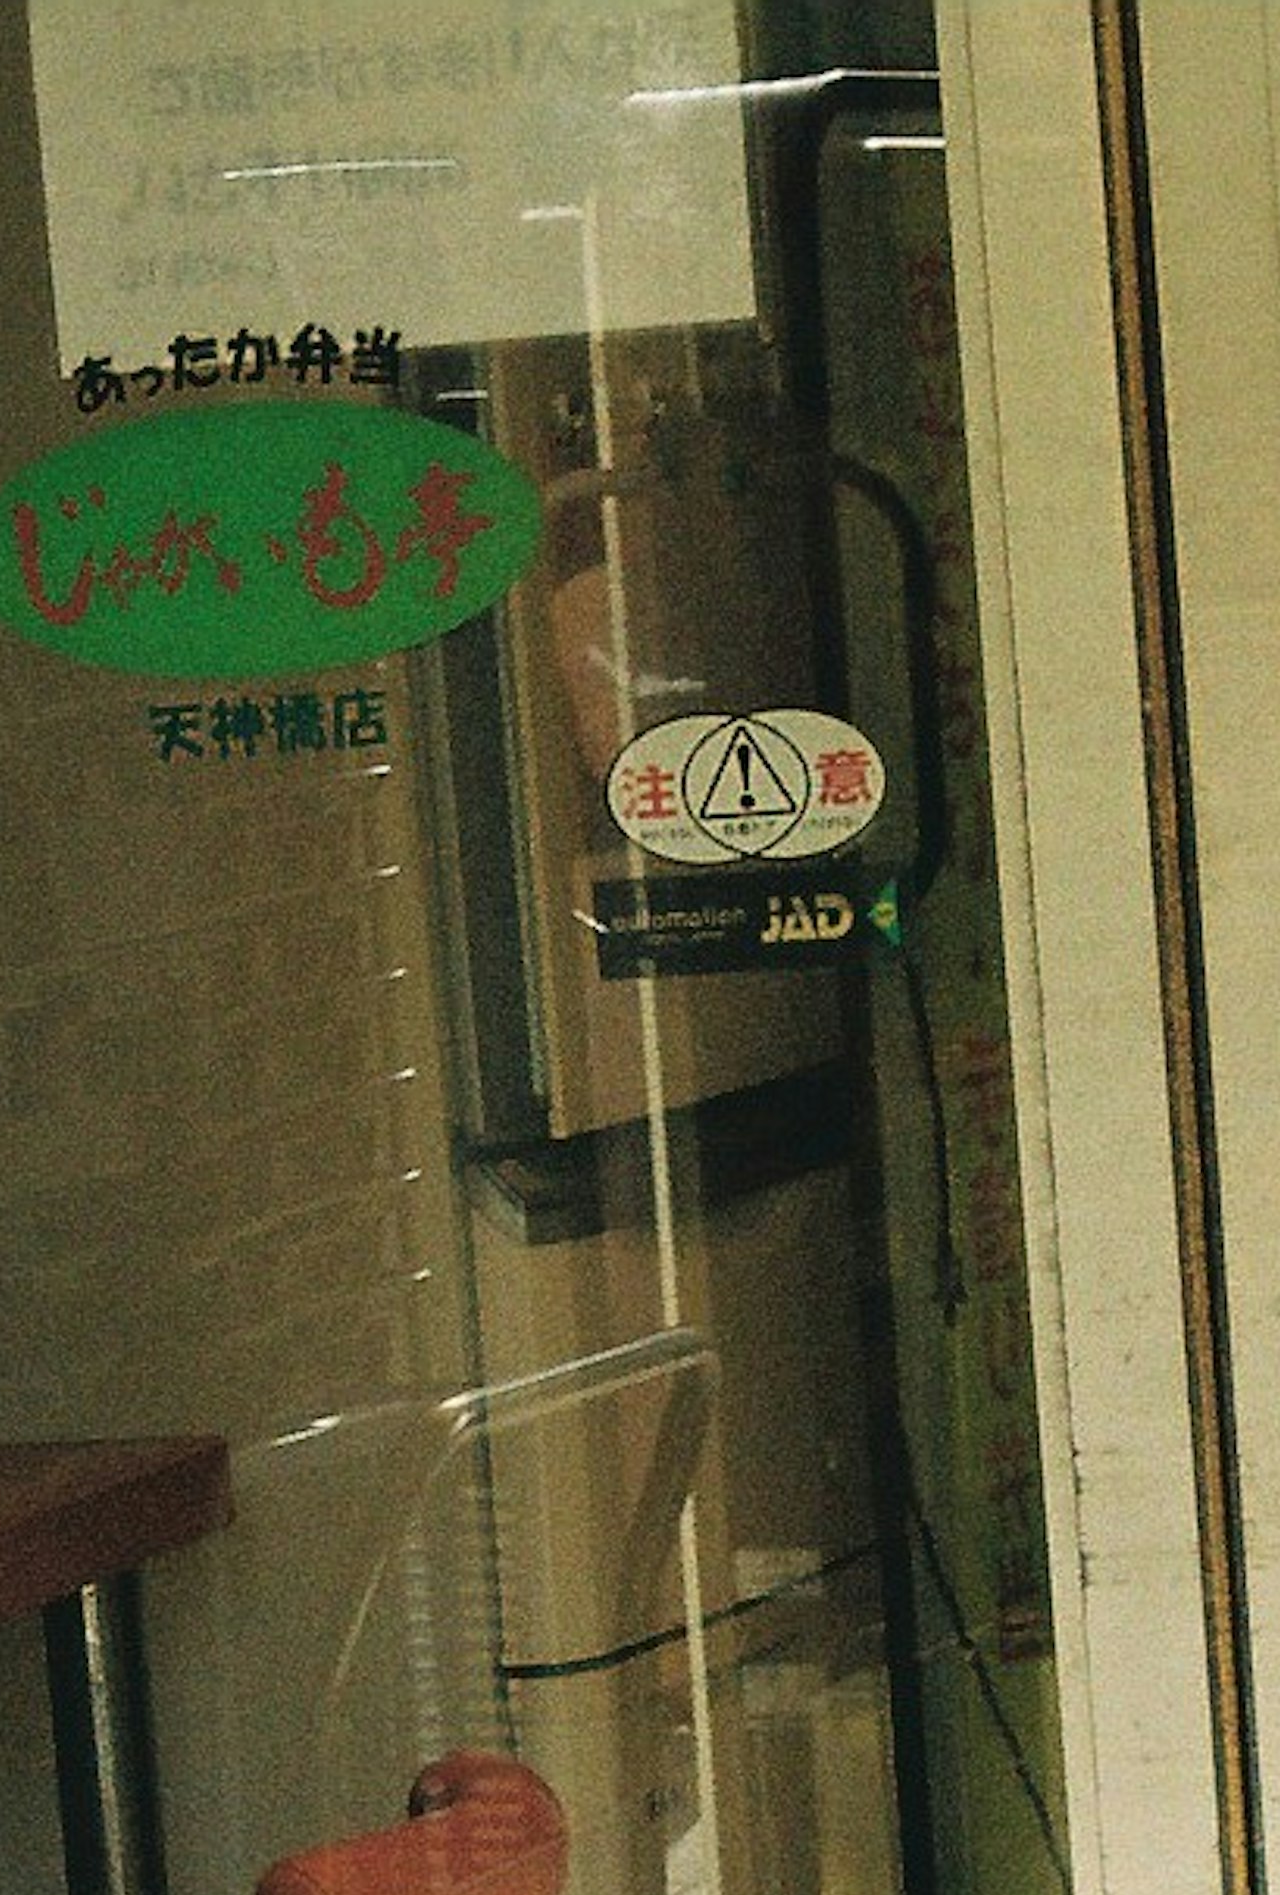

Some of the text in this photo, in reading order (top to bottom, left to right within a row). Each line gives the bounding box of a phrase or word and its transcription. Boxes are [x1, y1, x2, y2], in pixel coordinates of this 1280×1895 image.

[75, 322, 401, 412] あったか弁当
[13, 461, 495, 626] じゃがいも亭
[148, 689, 387, 762] 天神橋店
[621, 750, 872, 820] 注 意
[760, 893, 855, 944] JAD
